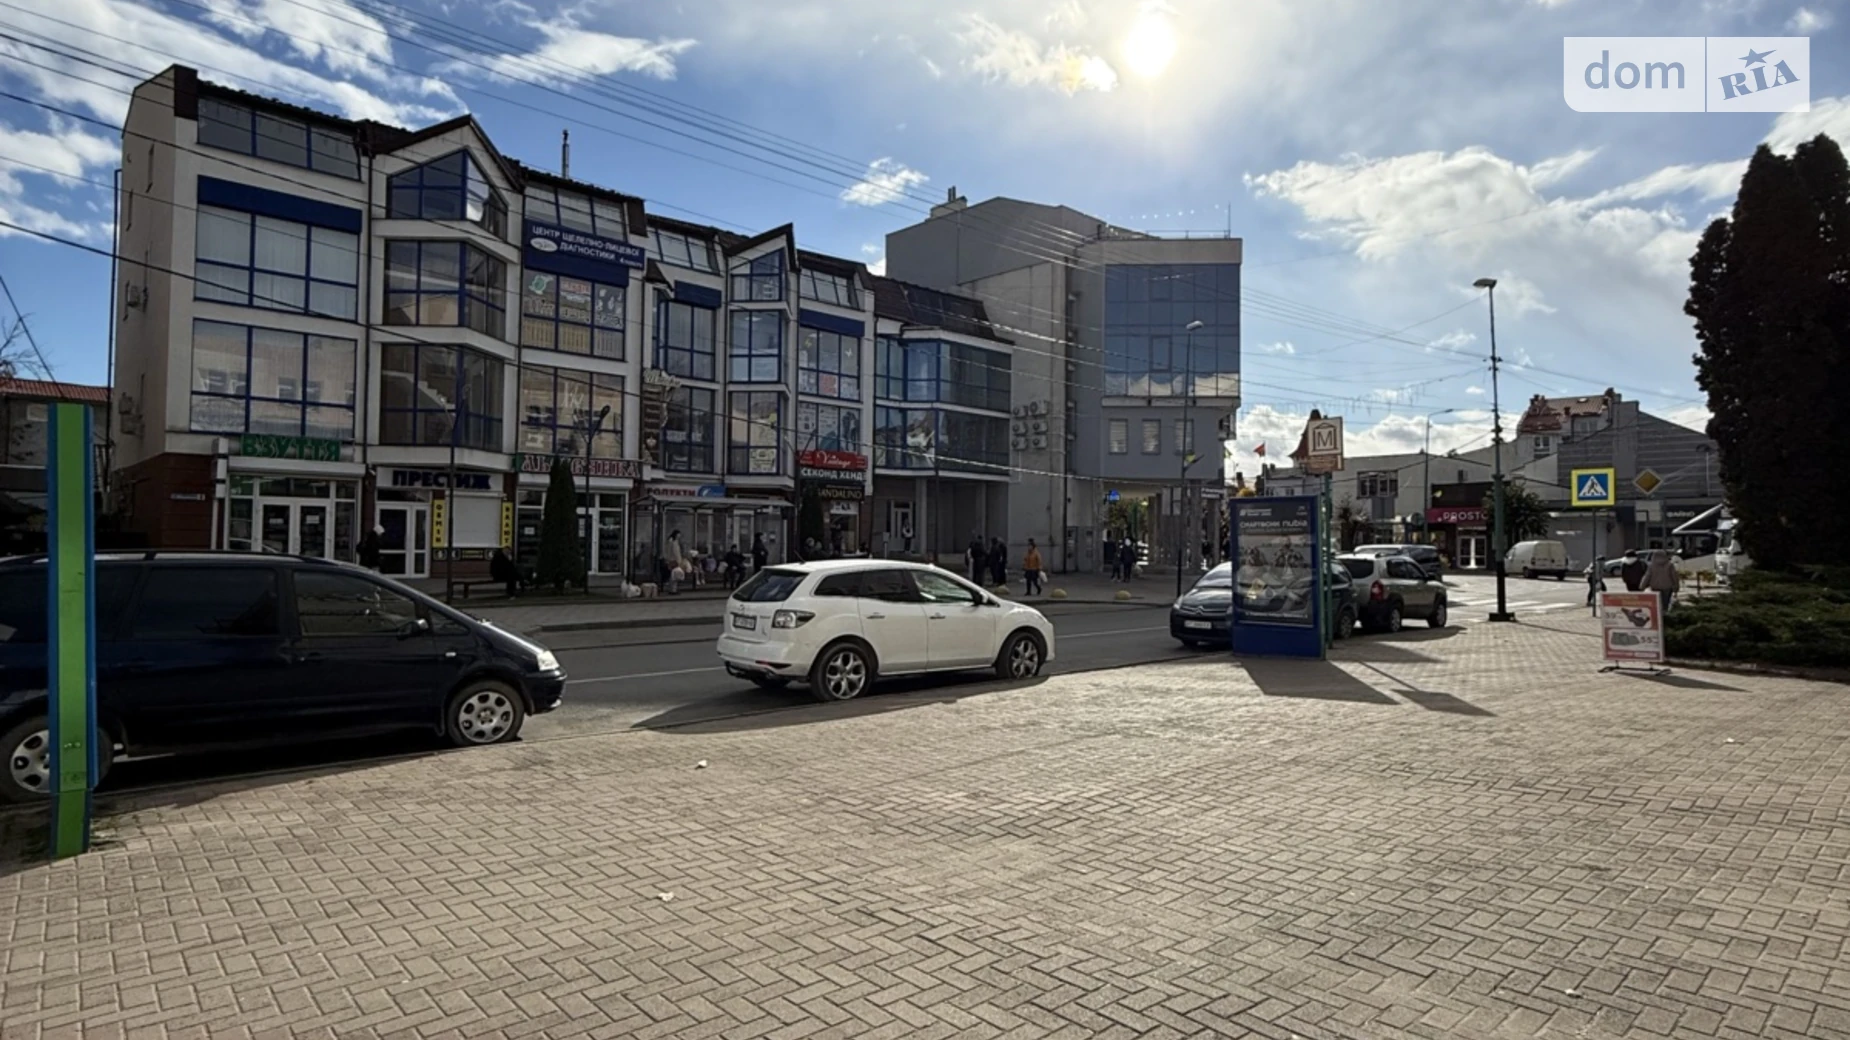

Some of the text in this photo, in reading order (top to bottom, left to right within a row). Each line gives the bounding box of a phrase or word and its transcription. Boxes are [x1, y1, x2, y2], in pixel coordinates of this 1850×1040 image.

[532, 225, 560, 238] ЦЕНТР
[560, 241, 616, 260] ДІАГНОСТИКИ
[242, 434, 340, 461] ВЗУТТЯ
[1317, 430, 1333, 447] M
[393, 470, 490, 489] ПРЕСТИЖ
[801, 468, 863, 481] СЕКОНД ХЕНД
